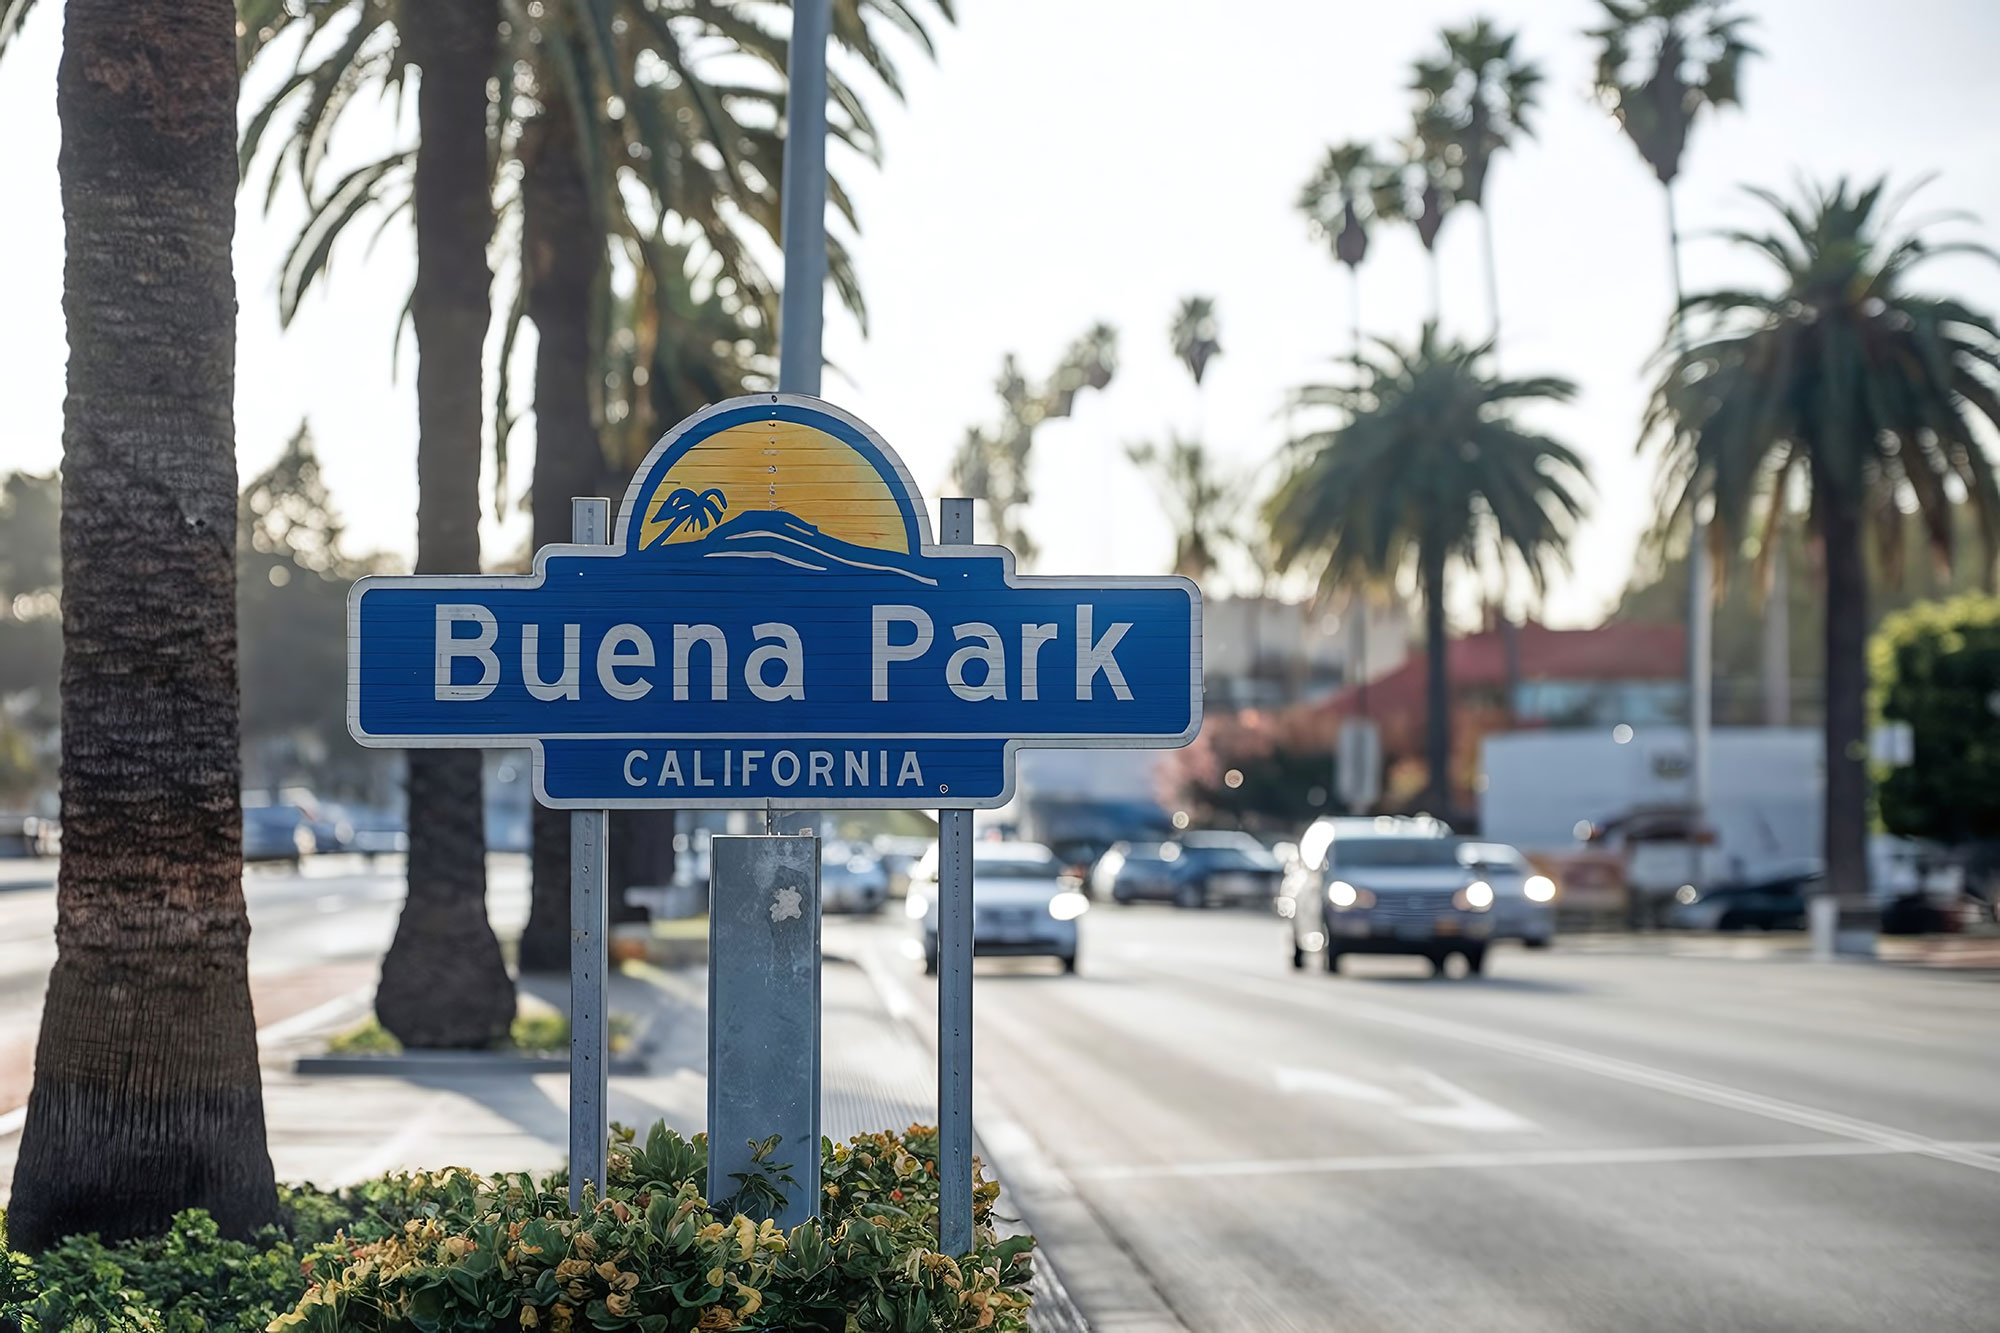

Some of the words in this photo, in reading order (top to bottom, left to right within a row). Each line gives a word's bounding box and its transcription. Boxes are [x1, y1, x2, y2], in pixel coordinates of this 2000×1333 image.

[435, 604, 805, 702] Buena
[872, 604, 1135, 702] Park
[624, 750, 924, 788] CALIFORNIA
